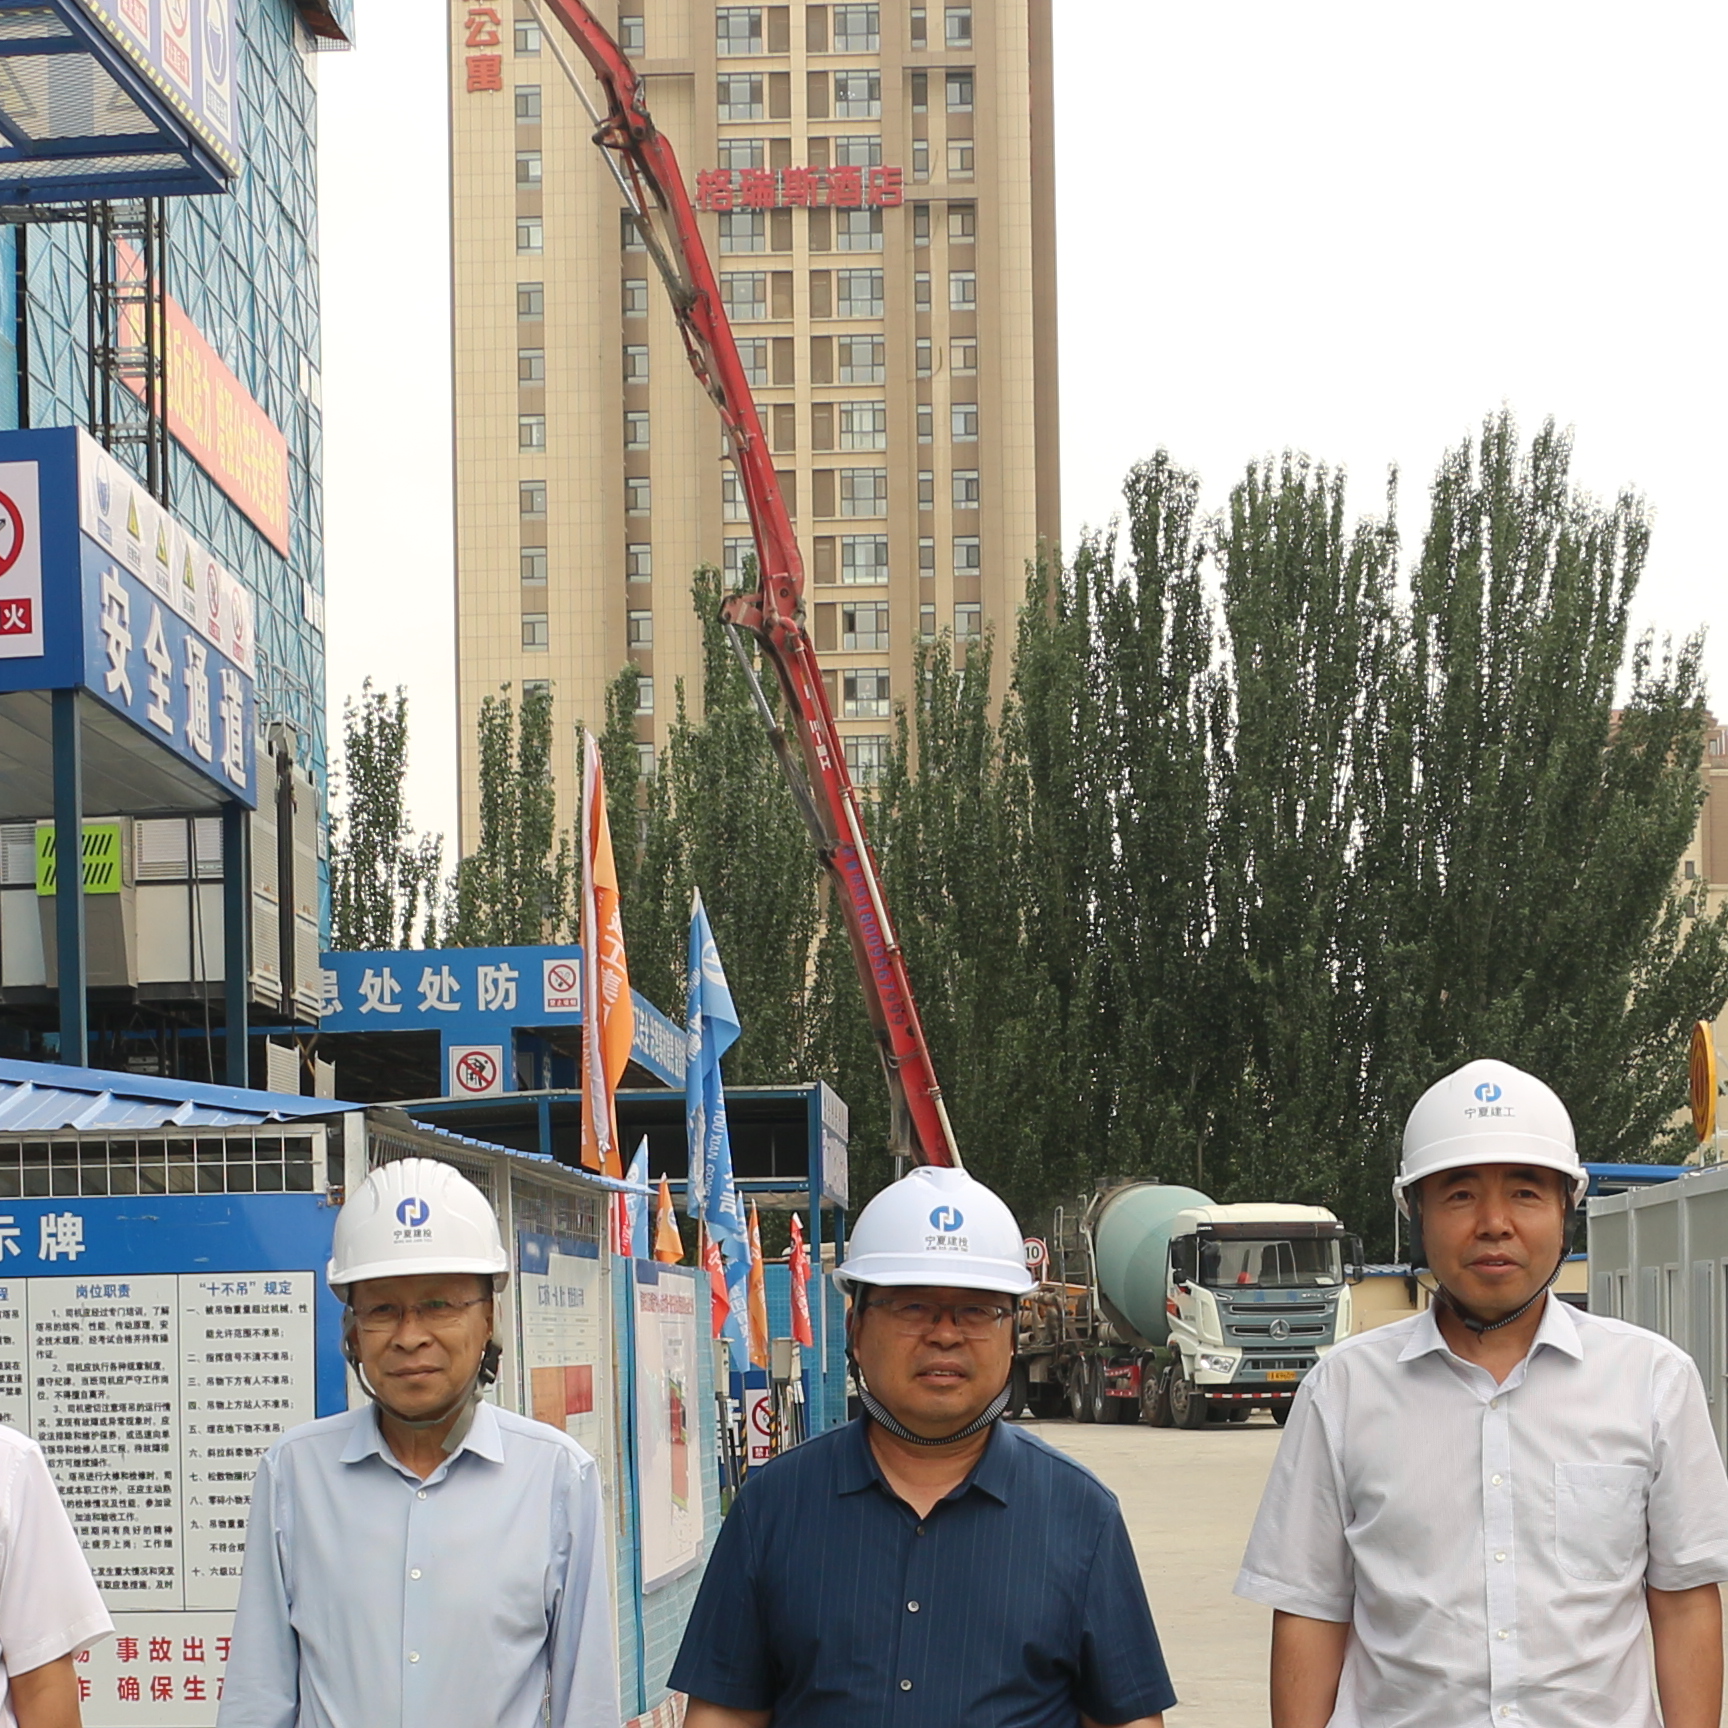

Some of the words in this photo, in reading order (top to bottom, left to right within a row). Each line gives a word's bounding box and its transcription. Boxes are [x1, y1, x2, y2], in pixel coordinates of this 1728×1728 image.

[464, 6, 502, 93] 公寓
[694, 165, 904, 212] 格瑞斯酒店
[101, 565, 248, 791] 安全通道
[1465, 1106, 1515, 1120] 宁夏建工
[1025, 1245, 1040, 1259] 10
[76, 1284, 131, 1299] 岗位职责
[264, 1281, 293, 1296] 规定
[190, 1518, 249, 1530] 九、吊物重量
